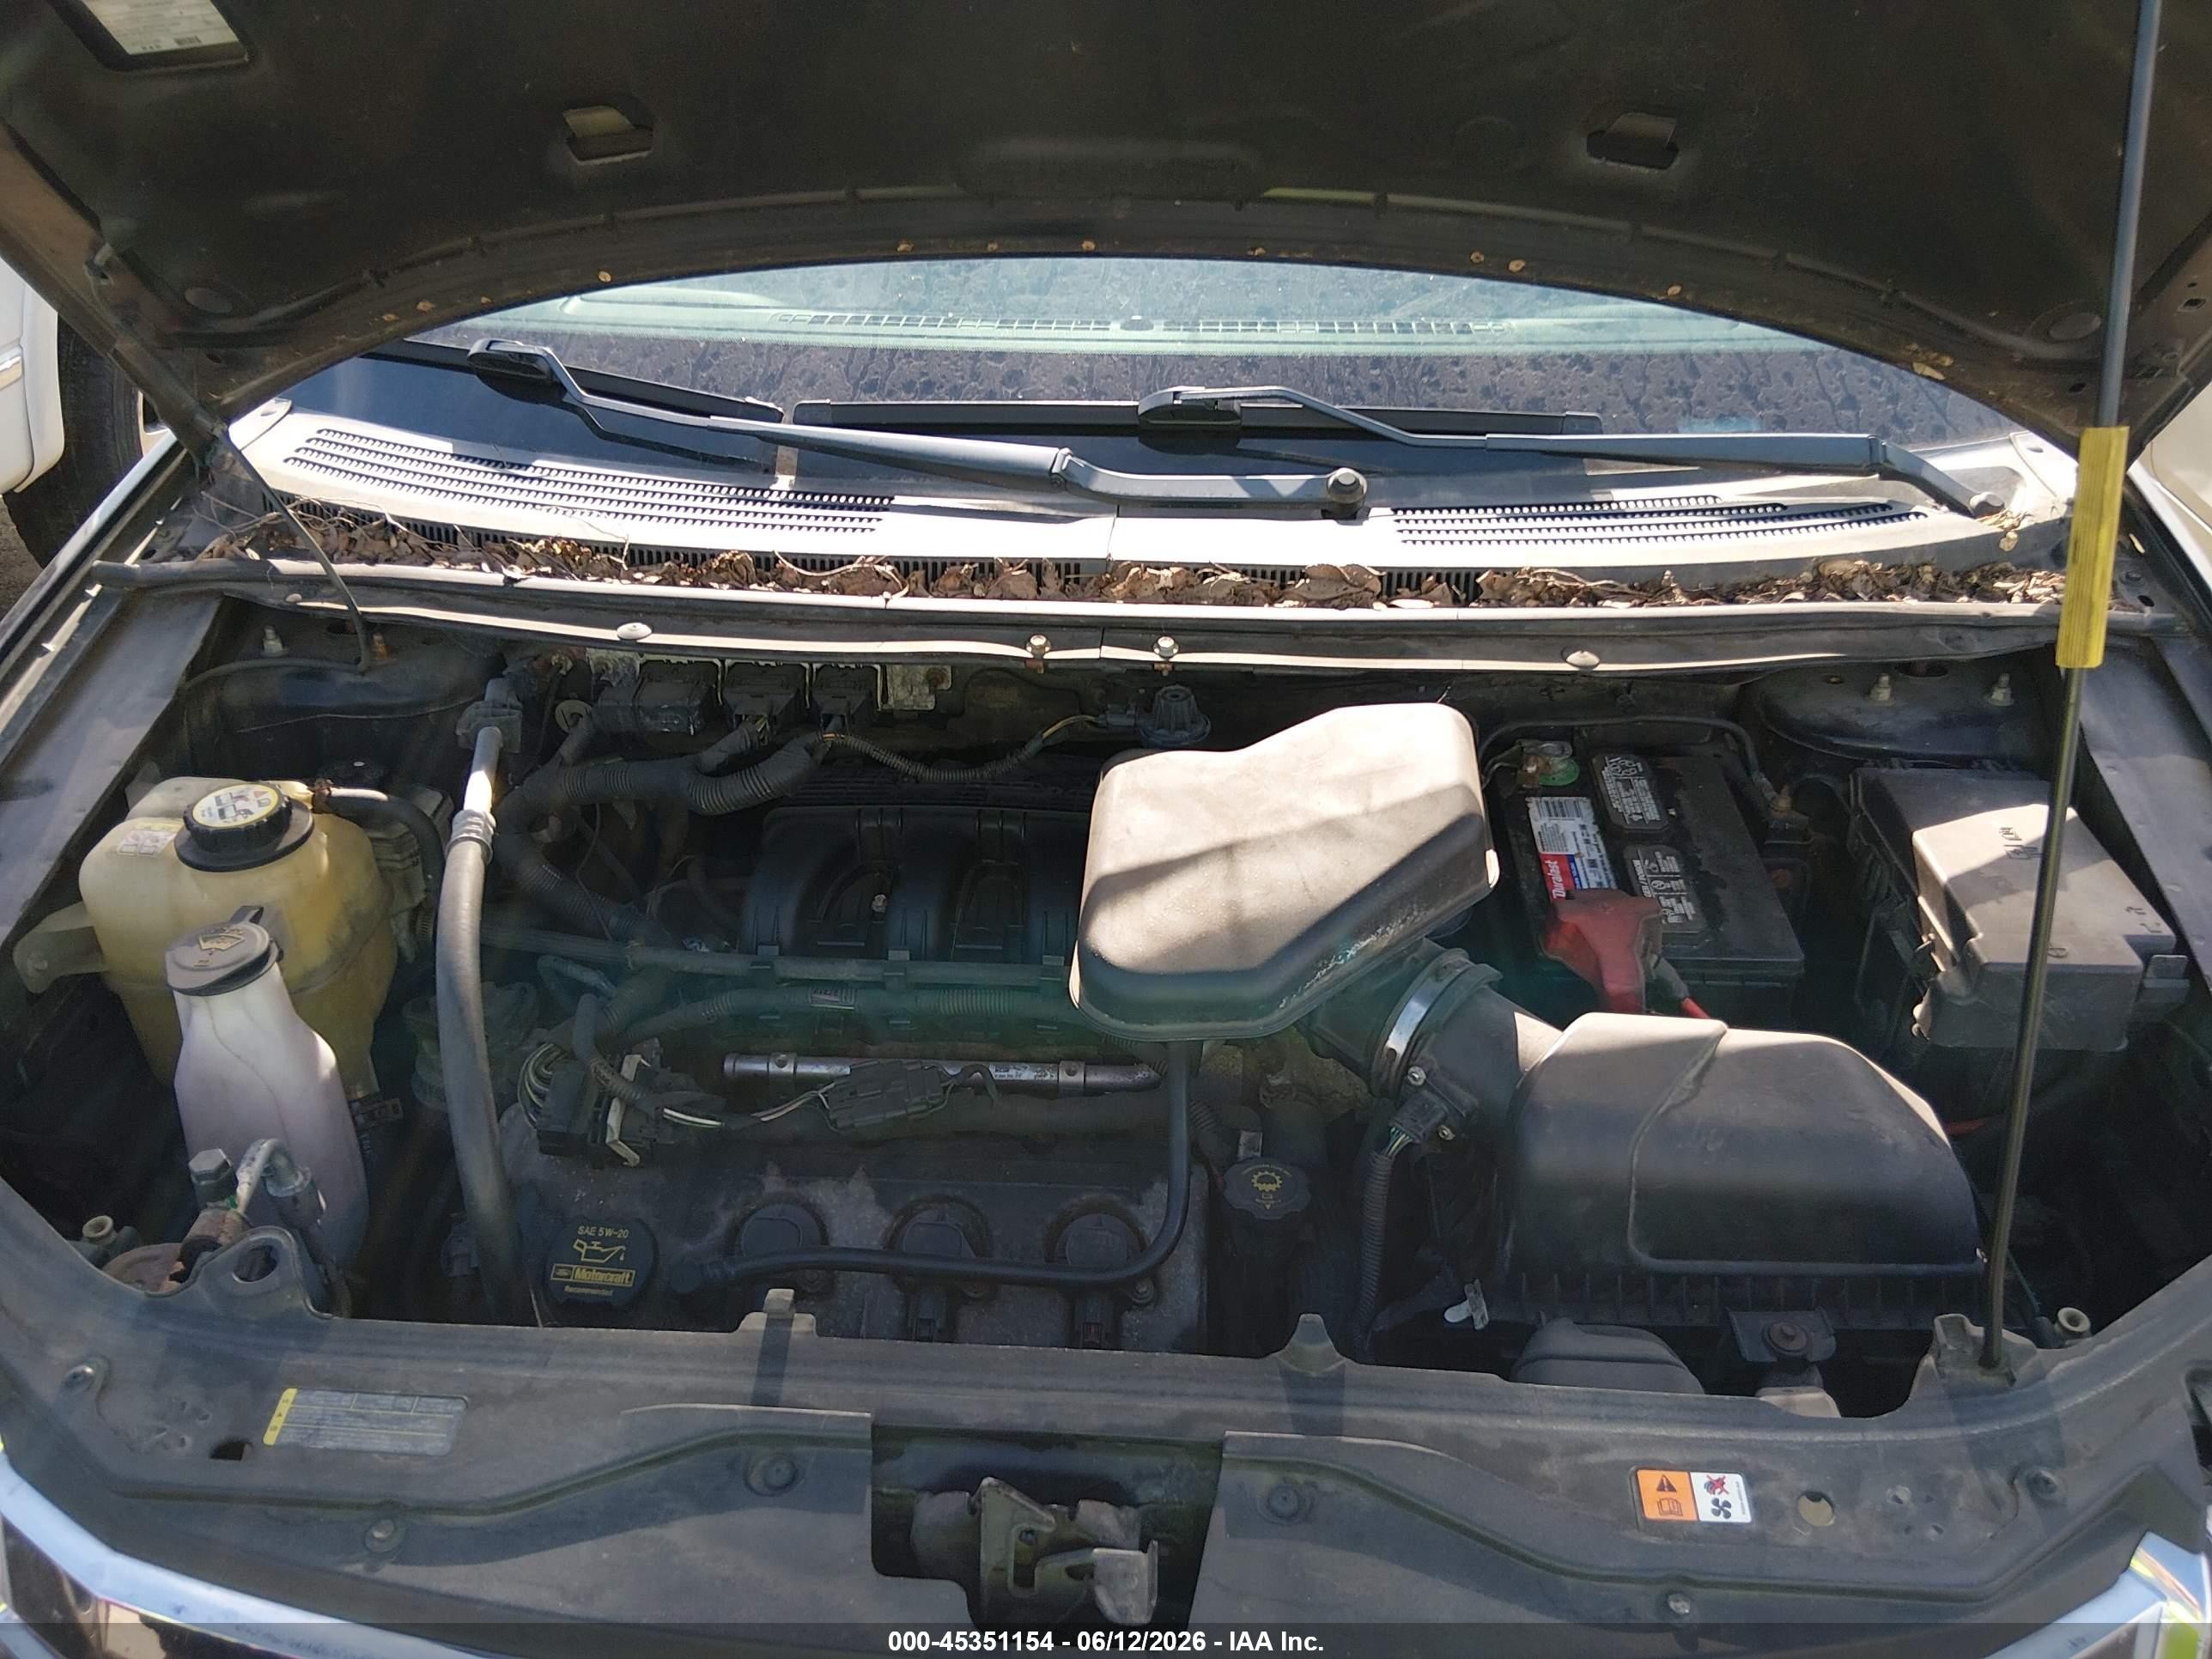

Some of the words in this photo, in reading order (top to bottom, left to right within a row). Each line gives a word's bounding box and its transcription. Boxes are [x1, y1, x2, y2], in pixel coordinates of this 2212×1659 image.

[1544, 860, 1566, 899] Duralast
[578, 1226, 597, 1236] SAE
[599, 1227, 629, 1237] 5W-20
[575, 1267, 631, 1284] Motorcraft
